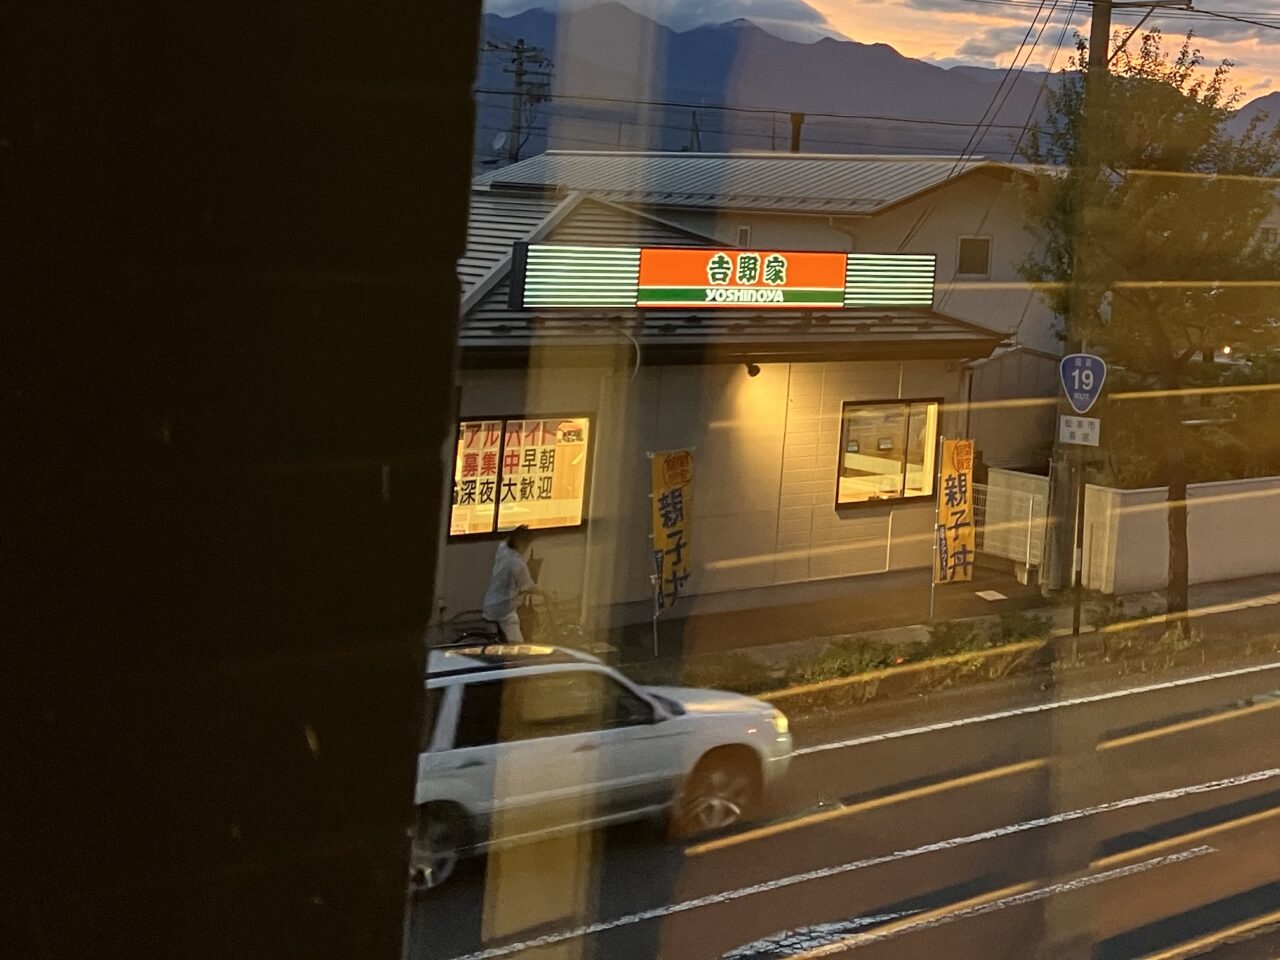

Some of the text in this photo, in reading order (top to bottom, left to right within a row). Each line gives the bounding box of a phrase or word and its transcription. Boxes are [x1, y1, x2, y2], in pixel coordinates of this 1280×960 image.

[705, 289, 784, 302] YOSHINOYA
[1071, 369, 1094, 390] 19
[465, 422, 557, 448] アルバイト
[460, 476, 553, 504] 深夜大歓迎
[944, 472, 973, 580] 親子丼
